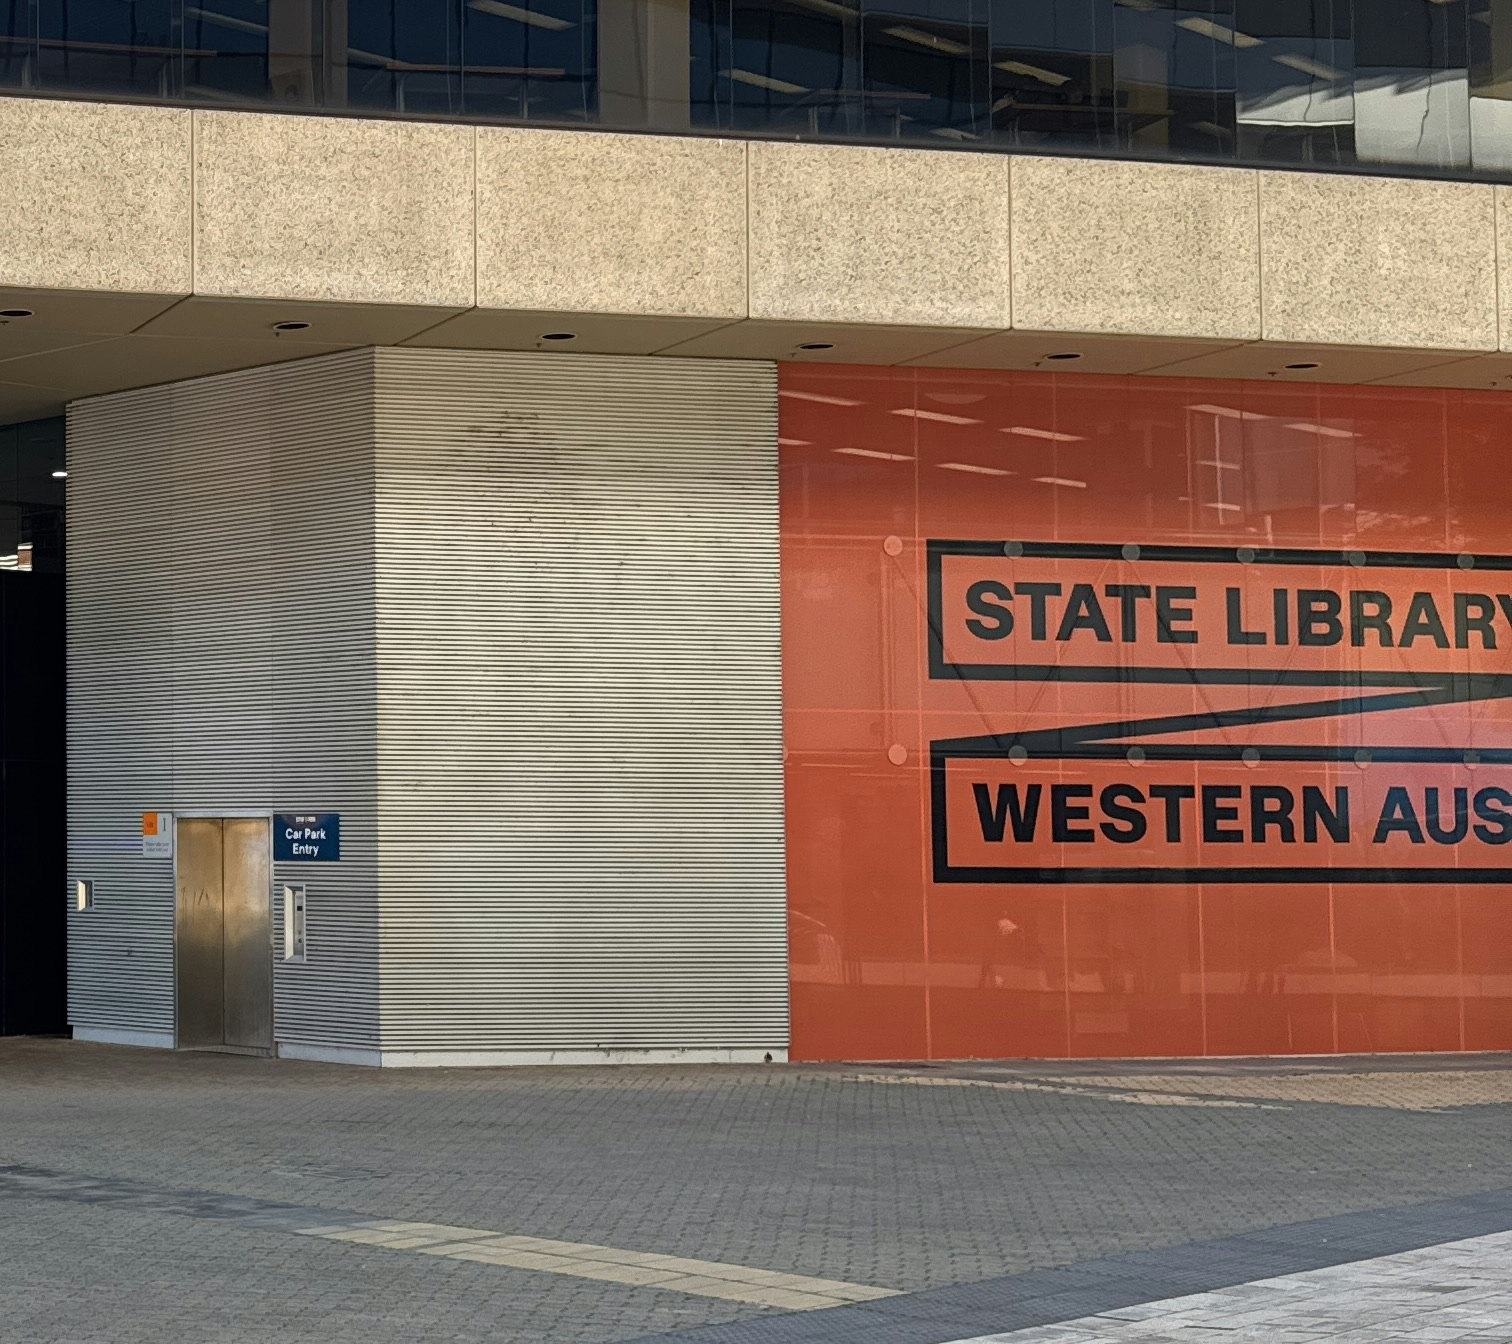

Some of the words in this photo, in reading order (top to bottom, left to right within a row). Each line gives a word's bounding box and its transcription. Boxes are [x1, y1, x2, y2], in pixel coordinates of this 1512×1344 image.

[965, 580, 1199, 645] STATE
[972, 783, 1351, 844] WESTERN
[1372, 787, 1512, 845] AUS
[285, 828, 302, 840] Car
[304, 828, 327, 840] Park
[292, 842, 319, 858] Entry
